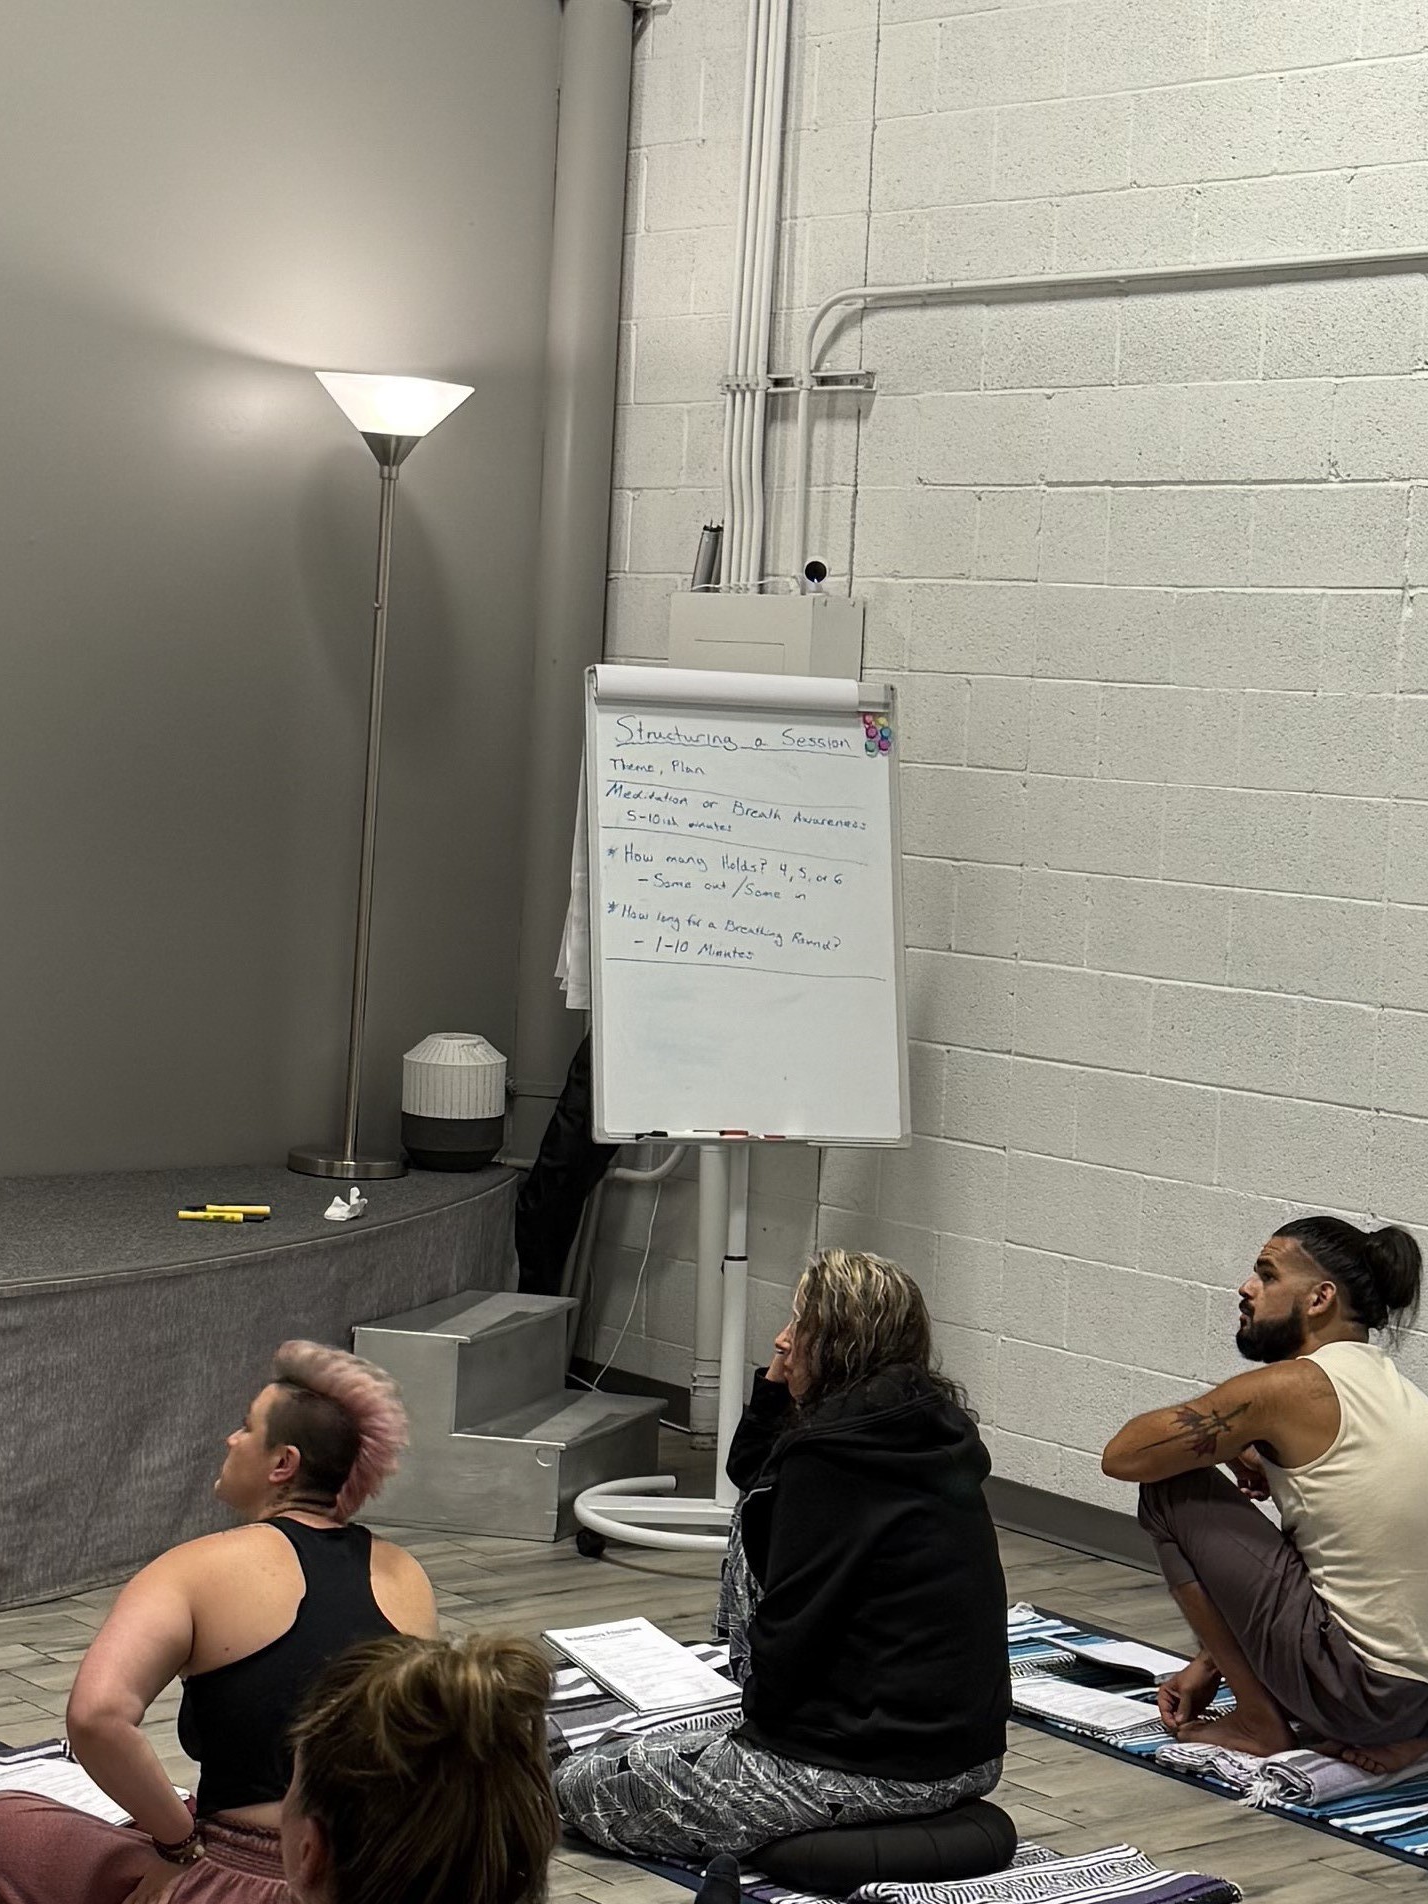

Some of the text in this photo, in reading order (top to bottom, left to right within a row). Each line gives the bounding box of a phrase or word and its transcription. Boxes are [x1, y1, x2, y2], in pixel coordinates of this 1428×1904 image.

[615, 714, 738, 751] Structuring
[782, 727, 852, 751] Session
[671, 759, 705, 775] Plan
[606, 781, 866, 831] Meditation or Breath Awareness
[624, 842, 654, 863] How
[665, 856, 708, 872] many
[833, 873, 844, 885] 6
[704, 881, 726, 890] out
[621, 904, 649, 921] How
[656, 912, 681, 932] long
[687, 914, 702, 928] for
[724, 919, 783, 948] Breathing
[655, 936, 753, 960] 1-10 Minutes
